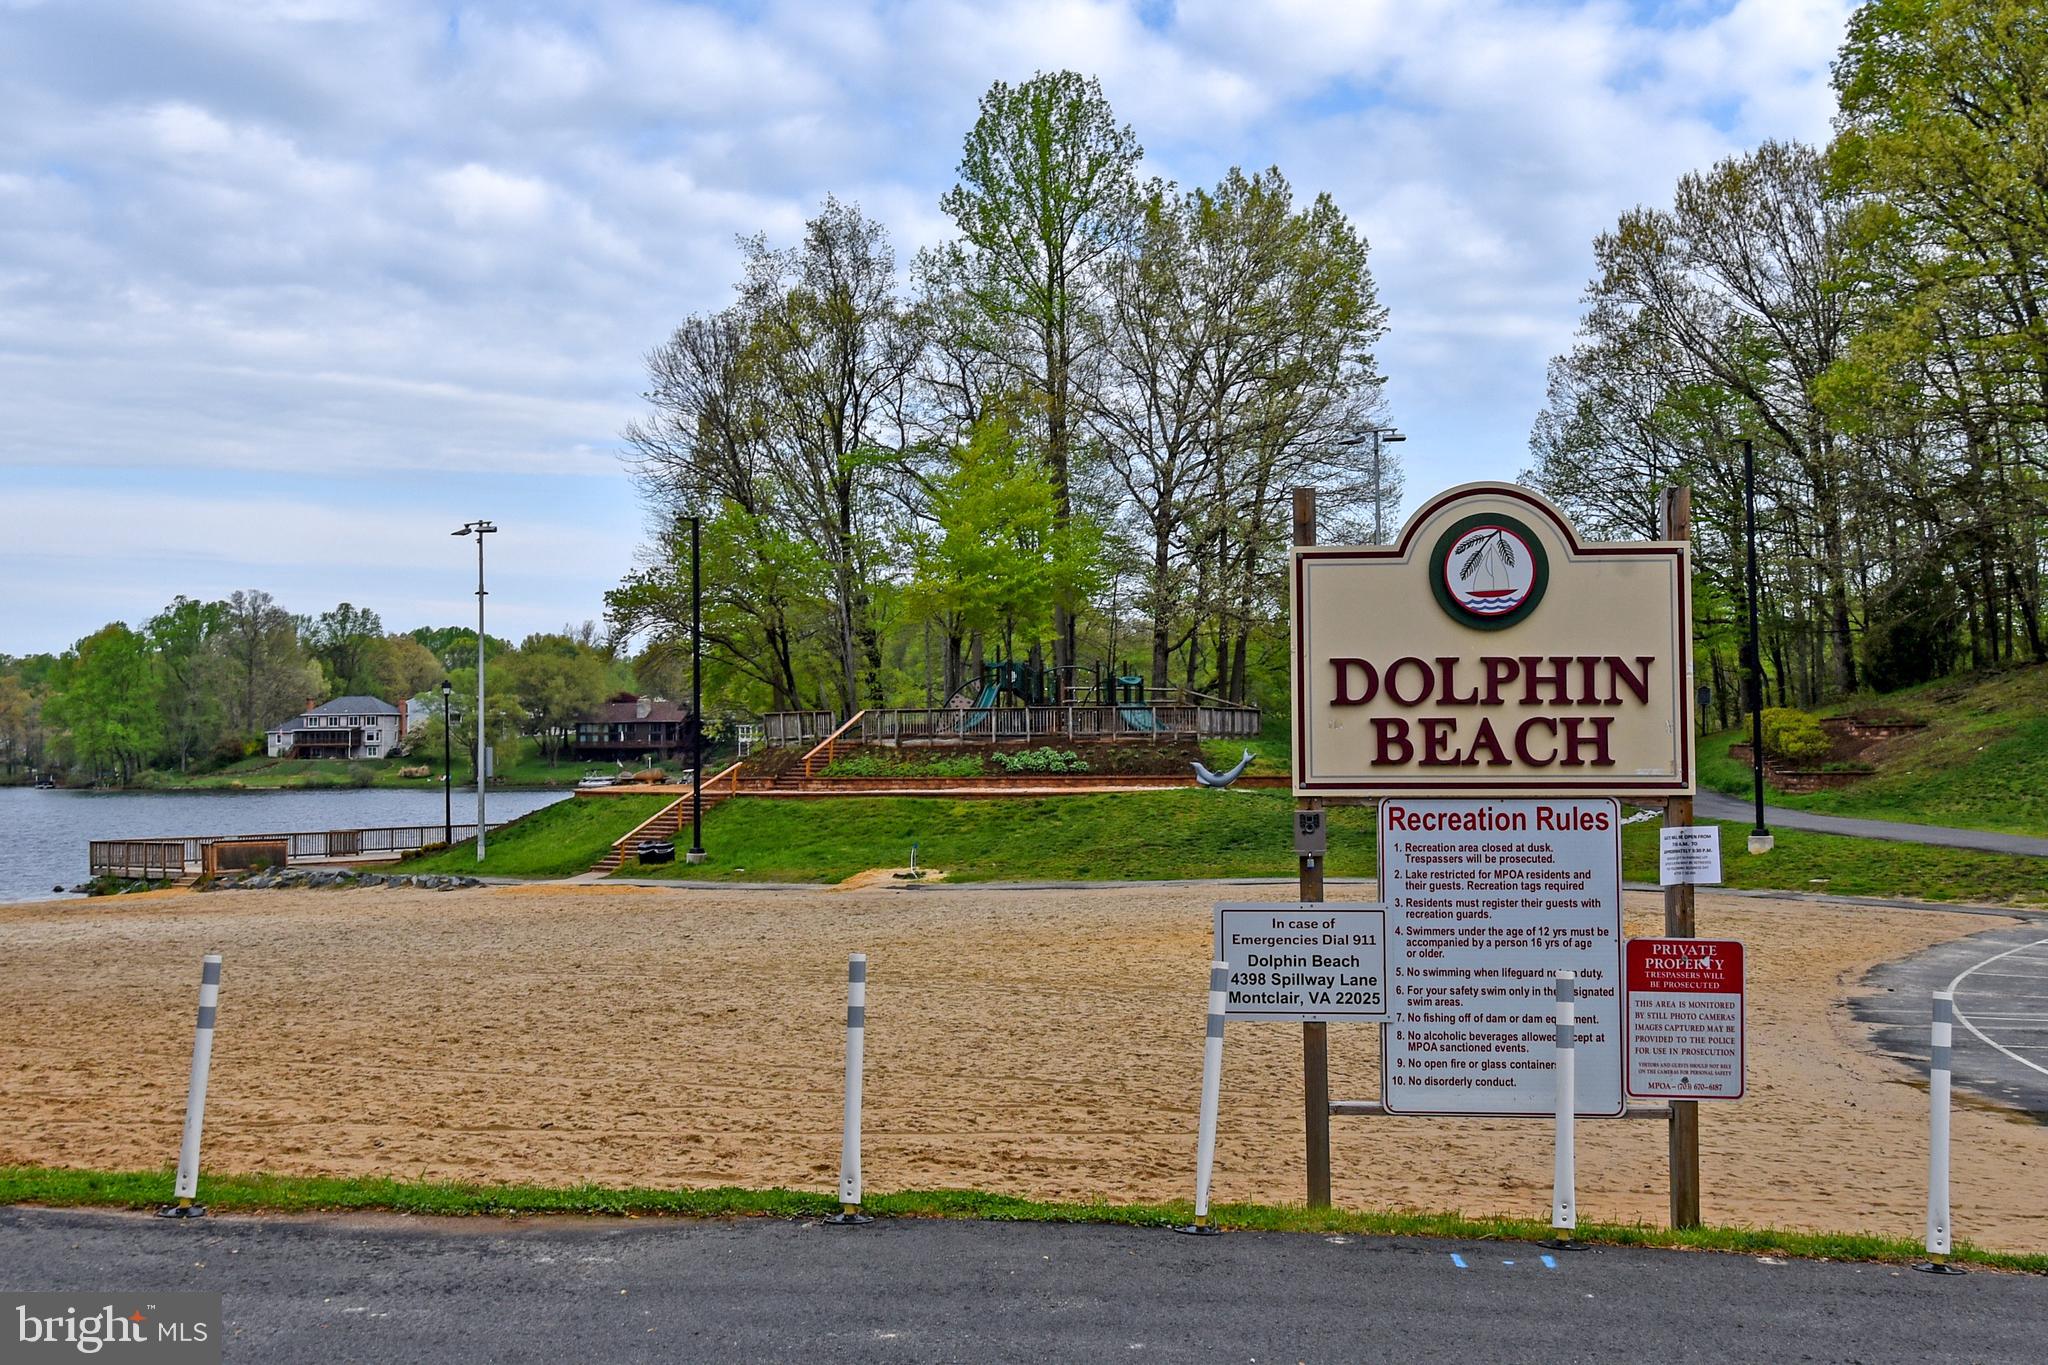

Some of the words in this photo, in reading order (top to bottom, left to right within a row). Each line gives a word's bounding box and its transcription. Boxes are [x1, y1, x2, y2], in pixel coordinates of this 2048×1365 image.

[1329, 656, 1655, 707] DOLPHIN
[1370, 717, 1616, 766] BEACH
[1389, 806, 1526, 831] Recreation
[1537, 806, 1609, 831] Rules
[1395, 843, 1401, 852] 1.
[1405, 843, 1455, 852] Recreation
[1482, 844, 1513, 853] closed
[1516, 844, 1525, 853] at
[1528, 844, 1553, 853] dusk.
[1405, 855, 1463, 864] Trespassers
[1466, 854, 1482, 863] will
[1485, 854, 1496, 863] be
[1499, 855, 1555, 865] prosecuted.
[1395, 870, 1402, 879] 2.
[1406, 870, 1427, 879] Lake
[1430, 870, 1475, 879] restricted
[1478, 870, 1491, 879] for
[1494, 870, 1524, 879] MPOA
[1526, 870, 1570, 879] residents
[1573, 870, 1591, 879] and
[1406, 882, 1426, 890] their
[1429, 883, 1464, 892] guests.
[1467, 882, 1518, 890] Recreation
[1521, 883, 1541, 891] tags
[1544, 882, 1584, 892] required
[1395, 899, 1402, 908] 3.
[1406, 899, 1452, 908] Residents
[1456, 900, 1479, 908] must
[1482, 899, 1518, 909] register
[1521, 899, 1542, 908] their
[1546, 900, 1578, 909] guests
[1581, 899, 1601, 908] with
[1406, 910, 1453, 919] recreation
[1456, 910, 1491, 920] guards.
[1272, 918, 1284, 928] In
[1289, 920, 1318, 929] case
[1322, 918, 1336, 929] of
[1395, 927, 1403, 936] 4.
[1407, 927, 1455, 936] Swimmers
[1459, 927, 1485, 936] under
[1489, 927, 1503, 936] the
[1506, 929, 1523, 937] age
[1526, 927, 1536, 936] of
[1539, 928, 1550, 936] 12
[1553, 929, 1567, 938] yrs
[1570, 928, 1594, 936] must
[1597, 928, 1609, 936] be
[1232, 935, 1318, 947] Emergencies
[1323, 935, 1349, 945] Dial
[1353, 935, 1376, 945] 911
[1407, 938, 1469, 949] accompanied
[1472, 938, 1483, 949] by
[1486, 939, 1492, 947] a
[1494, 940, 1528, 949] person
[1532, 939, 1542, 947] 16
[1545, 940, 1559, 949] yrs
[1562, 938, 1572, 947] of
[1575, 941, 1592, 949] age
[1419, 949, 1444, 958] older.
[1653, 944, 1717, 956] PRIVATE
[1248, 955, 1306, 969] Dolphin
[1312, 955, 1359, 967] Beach
[1396, 968, 1403, 977] 5.
[1407, 968, 1420, 977] No
[1423, 968, 1471, 979] swimming
[1474, 968, 1498, 977] when
[1501, 968, 1543, 979] lifeguard
[1581, 968, 1603, 979] duty.
[1645, 971, 1700, 979] TRESPASSERS
[1231, 973, 1266, 985] 4398
[1272, 973, 1334, 988] Spillway
[1341, 974, 1377, 986] Lane
[1396, 987, 1404, 996] 6.
[1407, 987, 1423, 996] For
[1426, 988, 1447, 998] your
[1450, 987, 1478, 998] safety
[1481, 987, 1506, 996] swim
[1509, 987, 1529, 998] only
[1532, 987, 1541, 996] in
[1573, 988, 1614, 998] signated
[1229, 991, 1304, 1006] Montclair,
[1309, 992, 1330, 1004] VA
[1336, 992, 1380, 1004] 22025
[1407, 998, 1432, 1006] swim
[1396, 1013, 1404, 1022] 7.
[1408, 1013, 1421, 1022] No
[1423, 1013, 1456, 1024] fishing
[1458, 1013, 1471, 1022] off
[1474, 1013, 1484, 1022] of
[1486, 1014, 1507, 1023] dam
[1522, 1014, 1543, 1023] dam
[1546, 1015, 1598, 1025] eqment.
[1699, 1013, 1735, 1021] CAMERAS
[1665, 1024, 1705, 1032] CAPTURED
[1397, 1031, 1405, 1040] 8.
[1408, 1031, 1421, 1040] No
[1423, 1031, 1466, 1040] alcoholic
[1469, 1032, 1518, 1042] beverages
[1573, 1034, 1593, 1044] cept
[1596, 1034, 1605, 1042] at
[1409, 1043, 1437, 1051] MPOA
[1440, 1043, 1492, 1052] sanctioned
[1682, 1048, 1735, 1056] PROSECUTION
[1397, 1059, 1405, 1068] 9.
[1409, 1059, 1422, 1068] No
[1425, 1061, 1448, 1070] open
[1450, 1059, 1466, 1068] fire
[1482, 1060, 1507, 1070] glass
[1392, 1077, 1405, 1086] 10.
[1409, 1077, 1422, 1086] No
[1425, 1077, 1472, 1088] disorderly
[1475, 1077, 1516, 1086] conduct.
